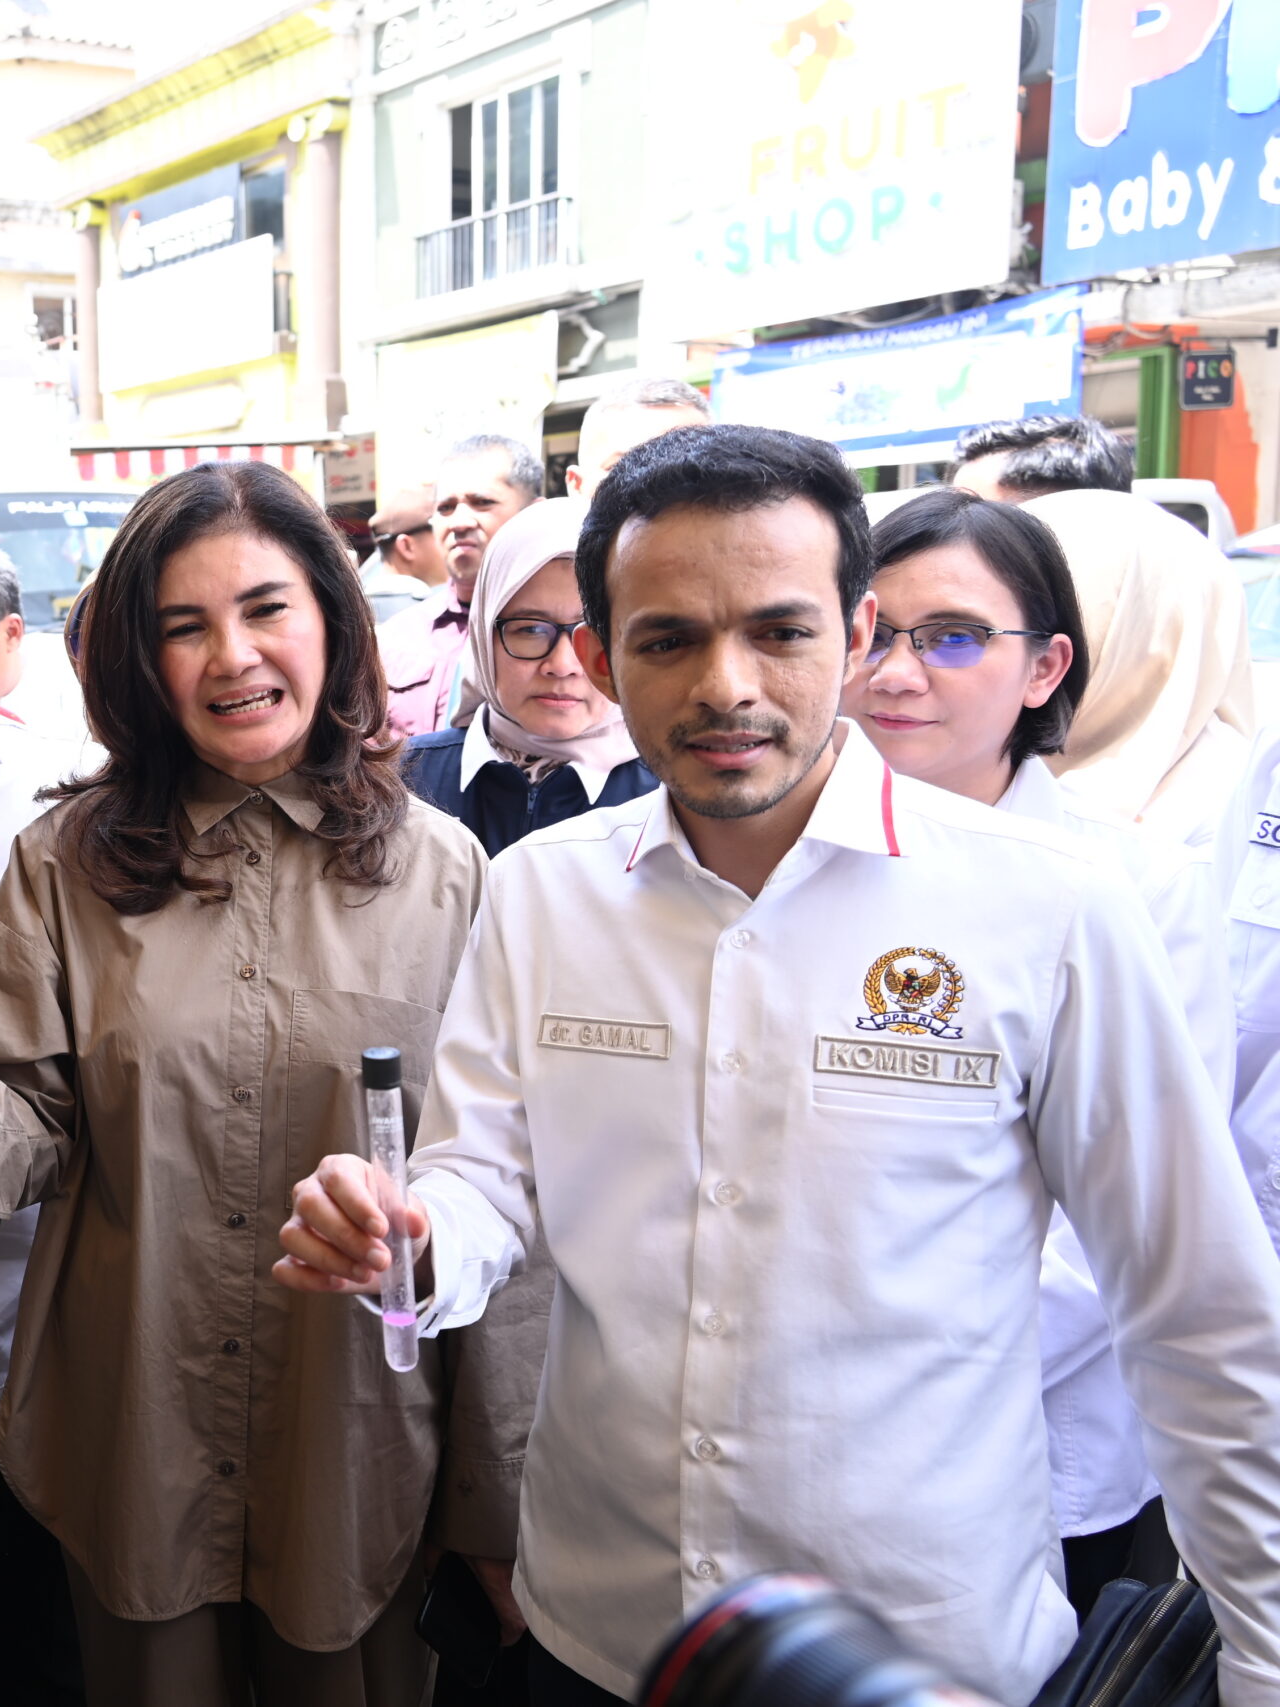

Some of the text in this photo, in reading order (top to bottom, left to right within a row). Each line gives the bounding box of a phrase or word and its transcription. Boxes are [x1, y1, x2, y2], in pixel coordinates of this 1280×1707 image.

[748, 82, 968, 196] FRUIT
[1067, 150, 1234, 250] Baby
[723, 184, 907, 276] SHOP
[1185, 359, 1233, 379] PICO
[578, 1023, 652, 1051] GAMAL
[882, 1013, 933, 1026] DPR-RI
[829, 1042, 985, 1081] KOMISI IX
